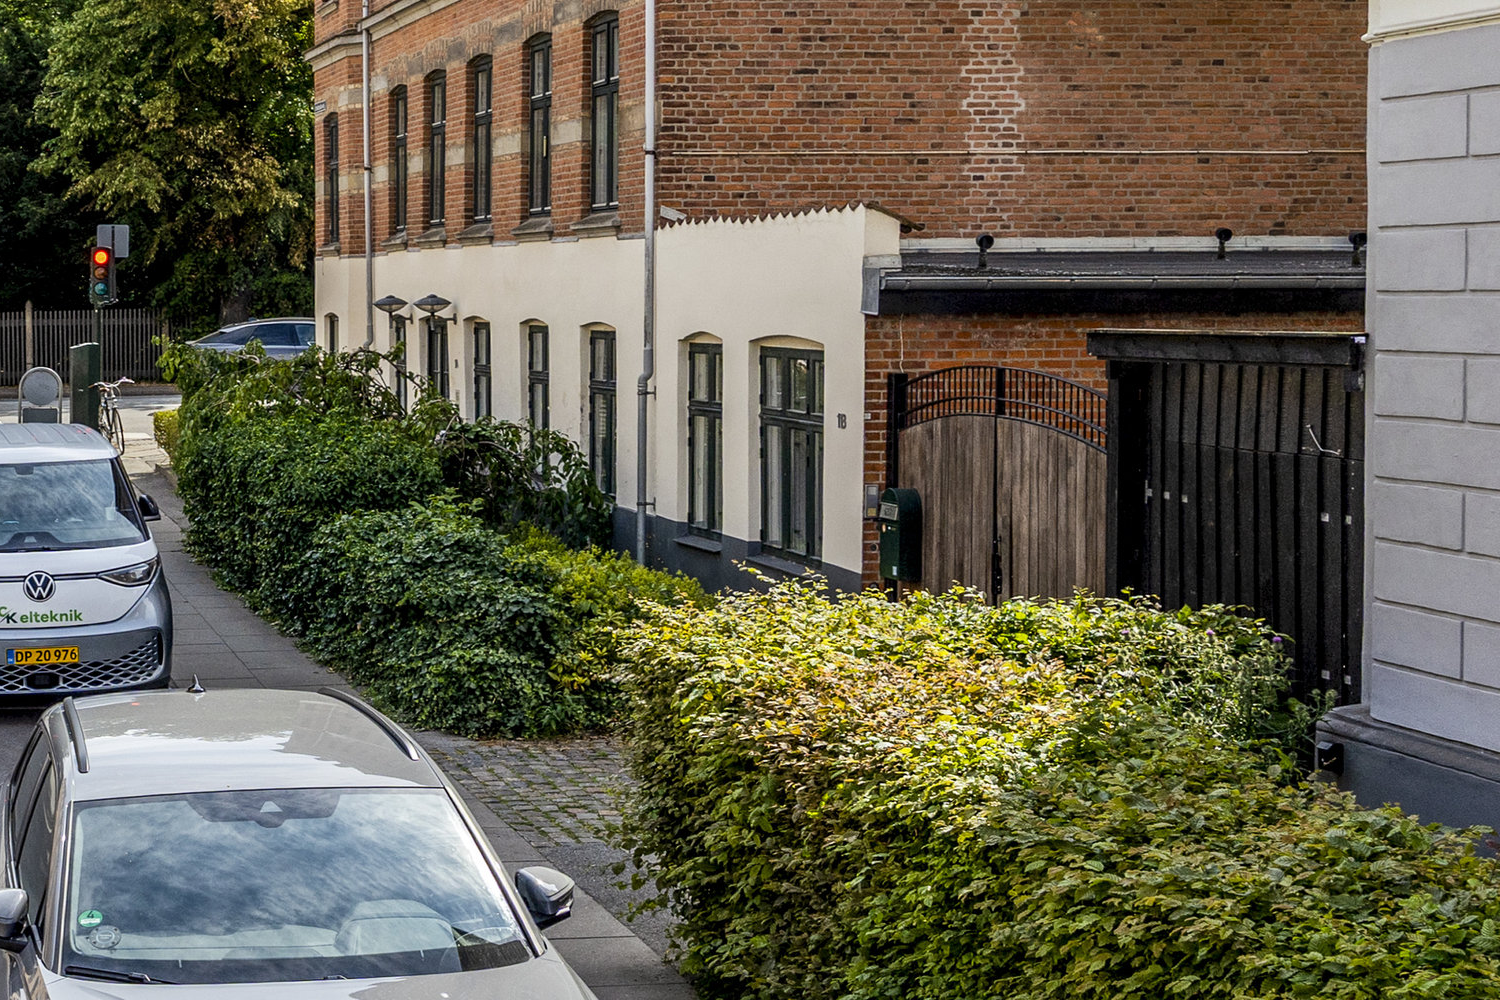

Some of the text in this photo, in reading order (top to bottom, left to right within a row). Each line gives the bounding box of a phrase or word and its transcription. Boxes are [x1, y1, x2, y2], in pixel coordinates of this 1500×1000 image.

[25, 572, 55, 600] VW
[19, 609, 84, 624] elteknik
[15, 648, 78, 663] DP 20 976
[87, 910, 95, 918] 4
